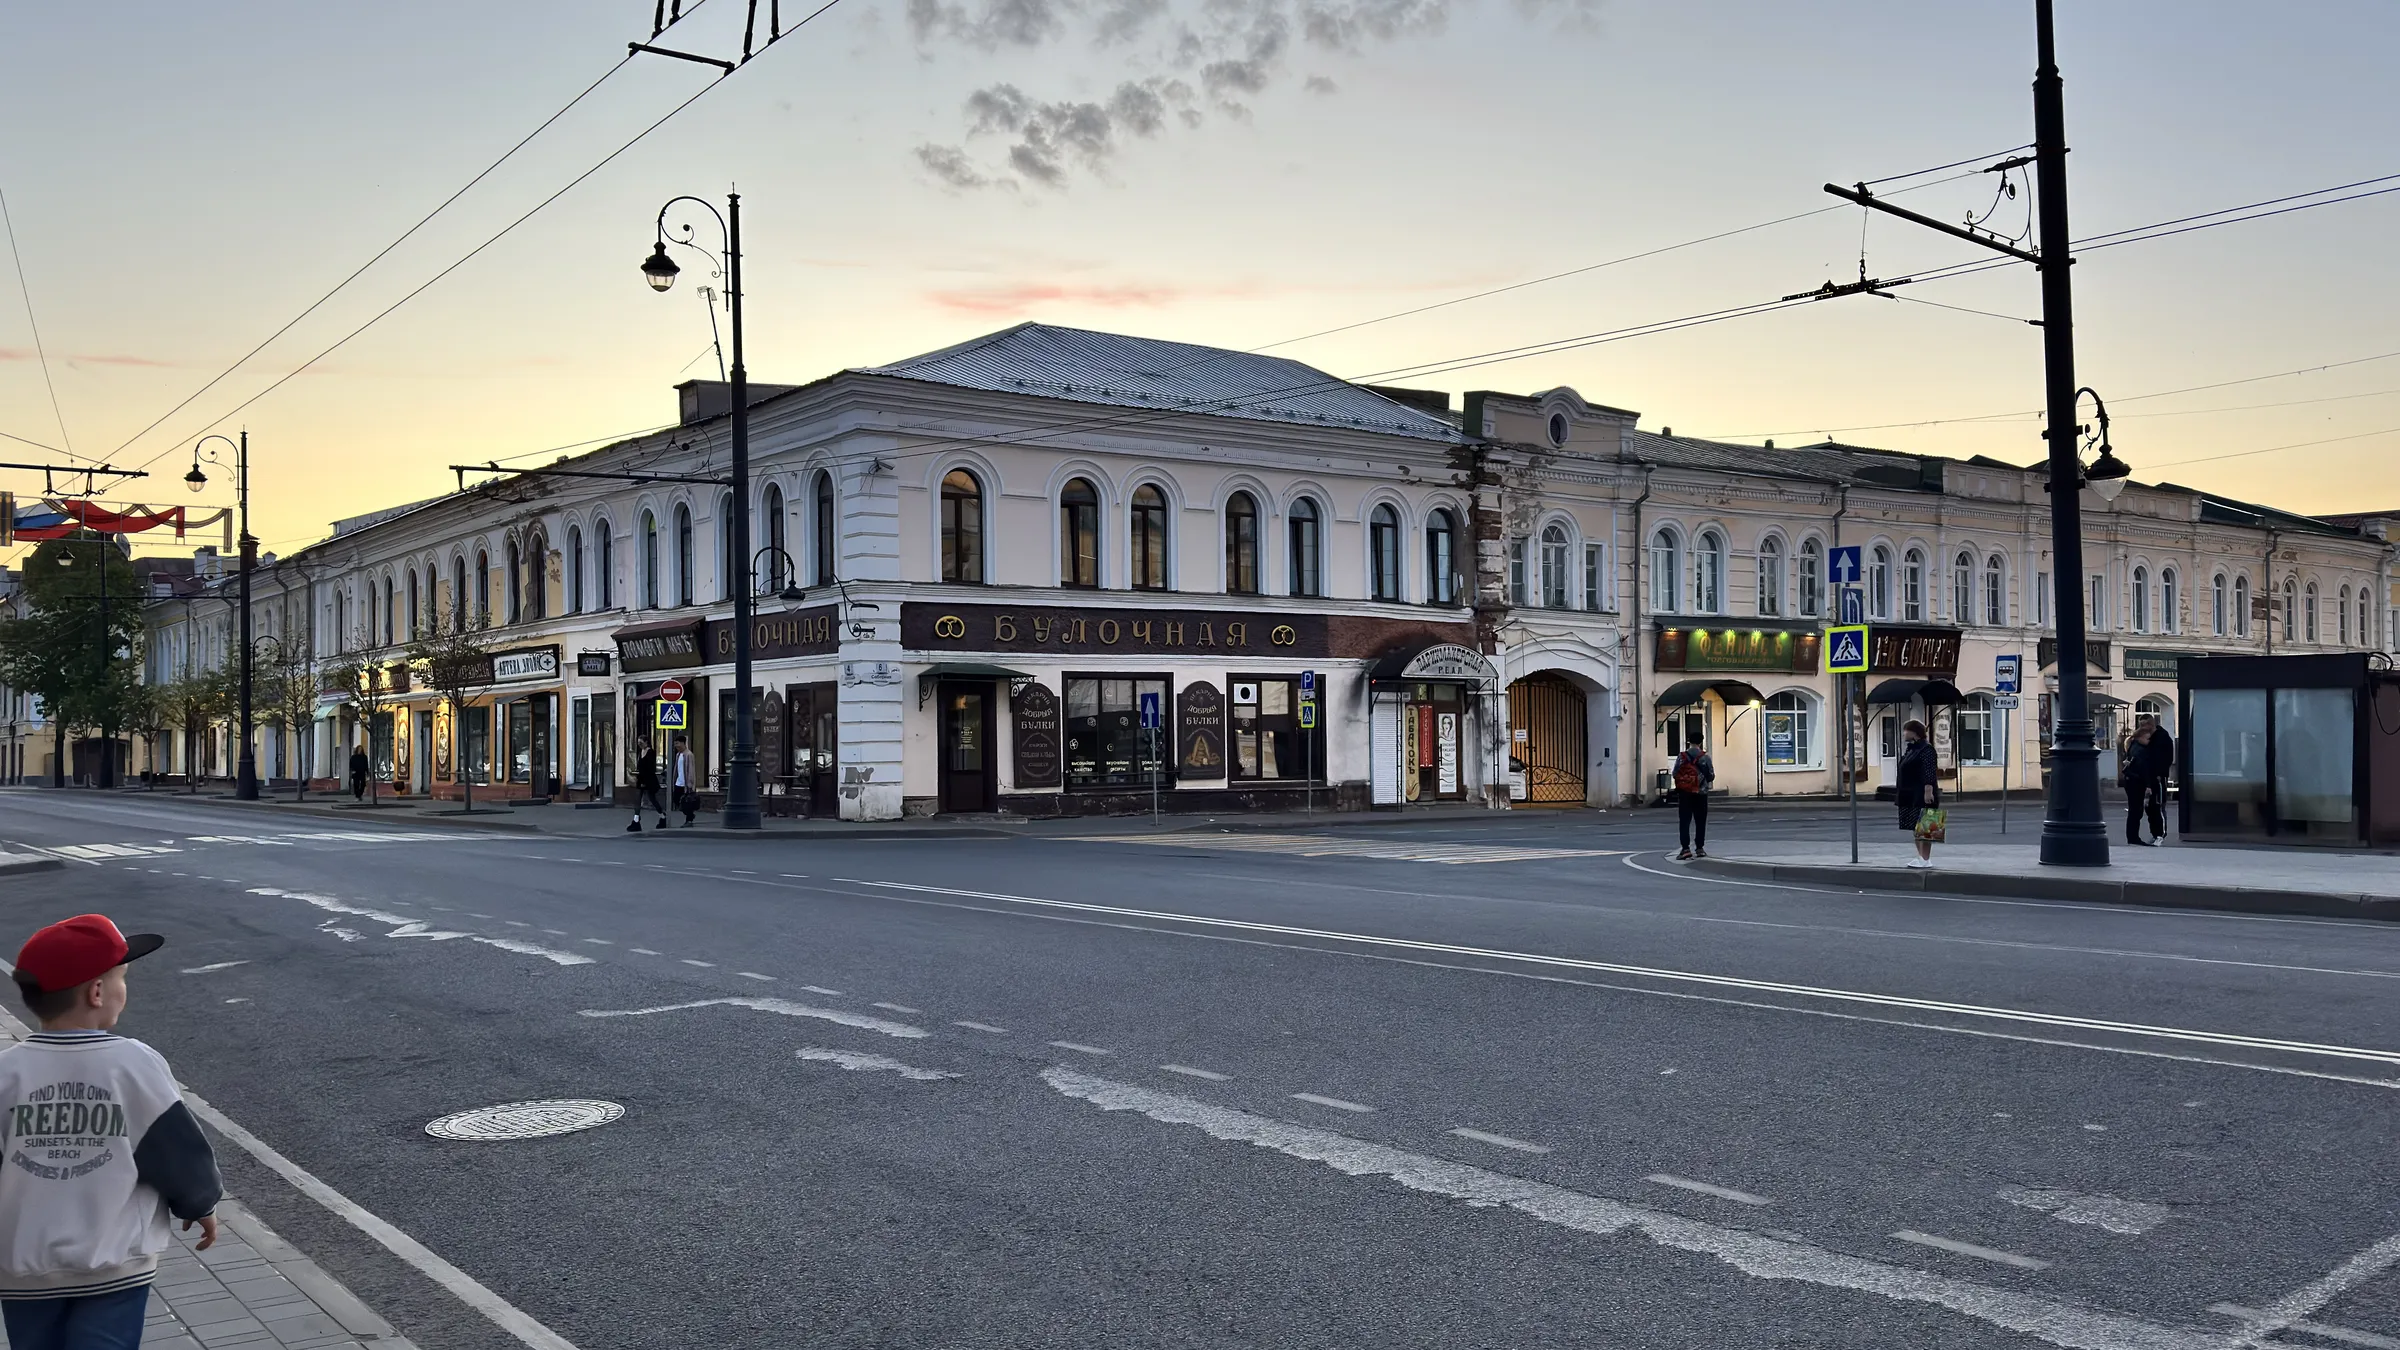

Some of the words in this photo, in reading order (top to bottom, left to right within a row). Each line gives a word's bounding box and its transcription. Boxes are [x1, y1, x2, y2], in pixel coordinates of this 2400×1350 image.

[717, 615, 831, 654] БОЧНАЯ
[993, 615, 1248, 647] БУЛОЧНАЯ
[1416, 646, 1484, 673] ПАРИКМАХЕРСКАЯ
[1021, 720, 1056, 730] БУЛКИ
[1186, 716, 1219, 725] БУЛКИ
[1407, 708, 1416, 774] ТАБАЧОКЪ
[29, 1085, 55, 1102] FIND
[57, 1081, 85, 1100] YOUR
[87, 1085, 112, 1101] OWN
[9, 1102, 128, 1137] REEDOM
[25, 1137, 72, 1148] SUNSETS
[74, 1137, 86, 1146] AT
[86, 1138, 105, 1147] THE
[47, 1149, 81, 1160] BEACH
